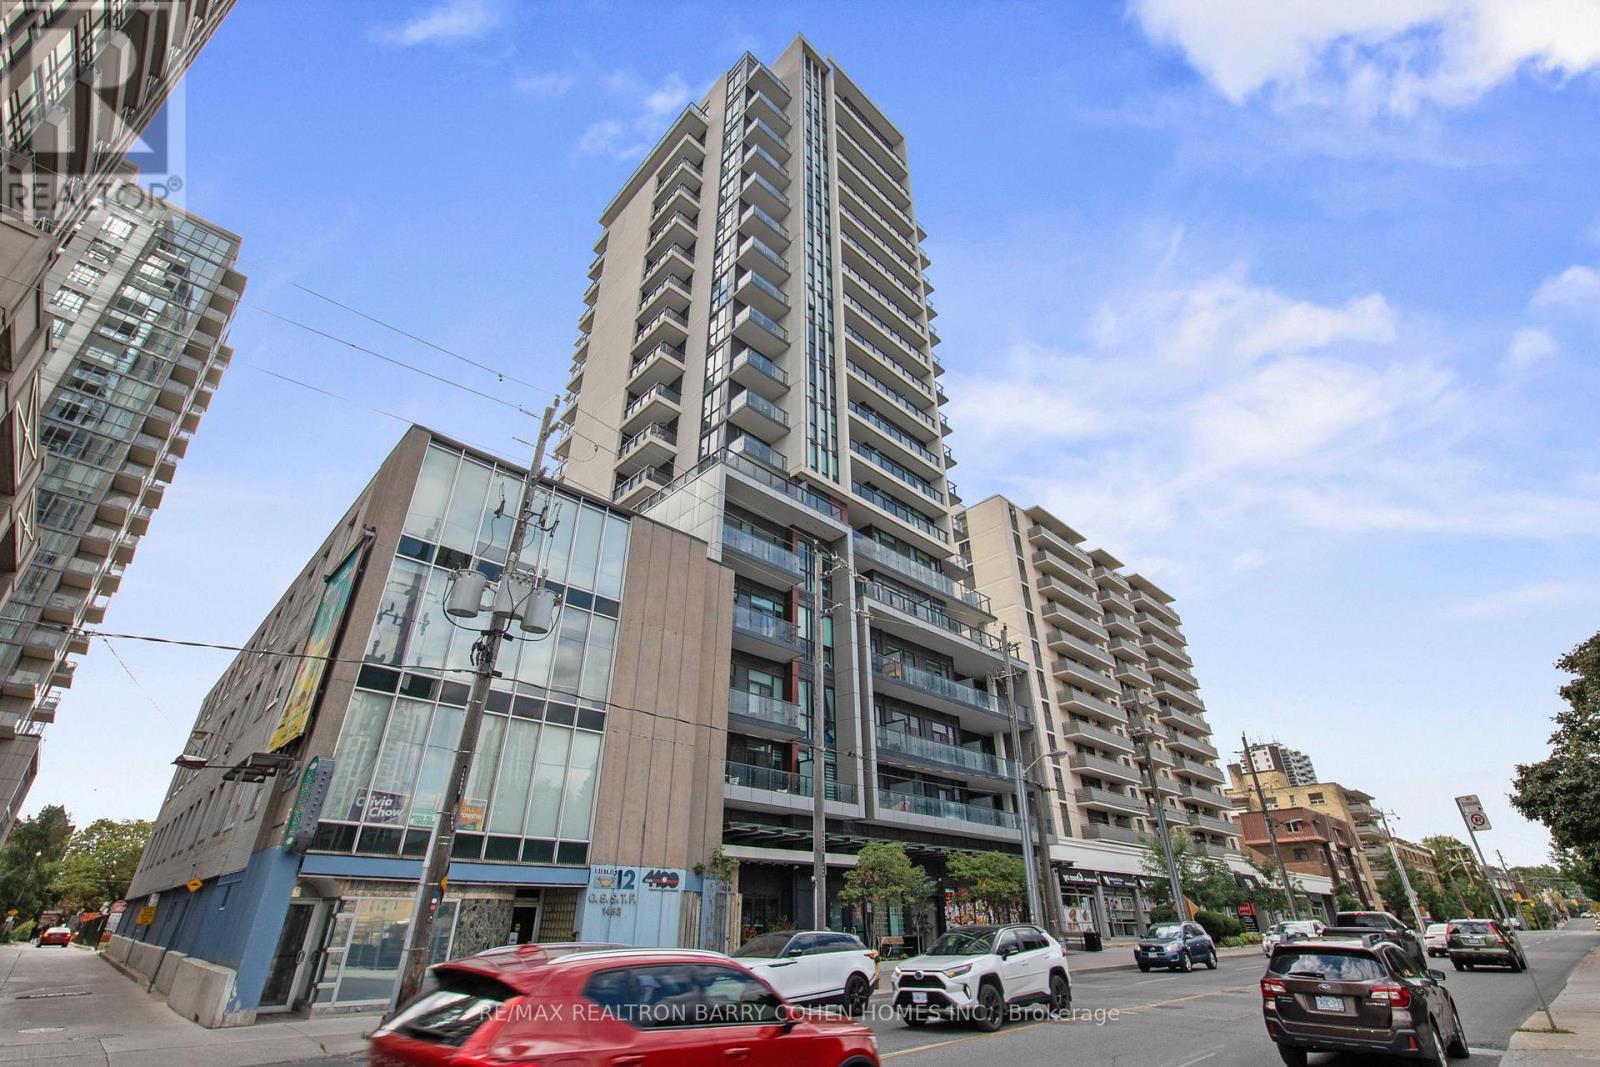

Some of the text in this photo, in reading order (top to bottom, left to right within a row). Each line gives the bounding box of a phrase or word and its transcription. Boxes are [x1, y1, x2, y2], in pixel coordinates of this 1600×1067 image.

[355, 796, 393, 808] Oivia
[367, 807, 403, 818] Chow
[617, 869, 636, 889] 12
